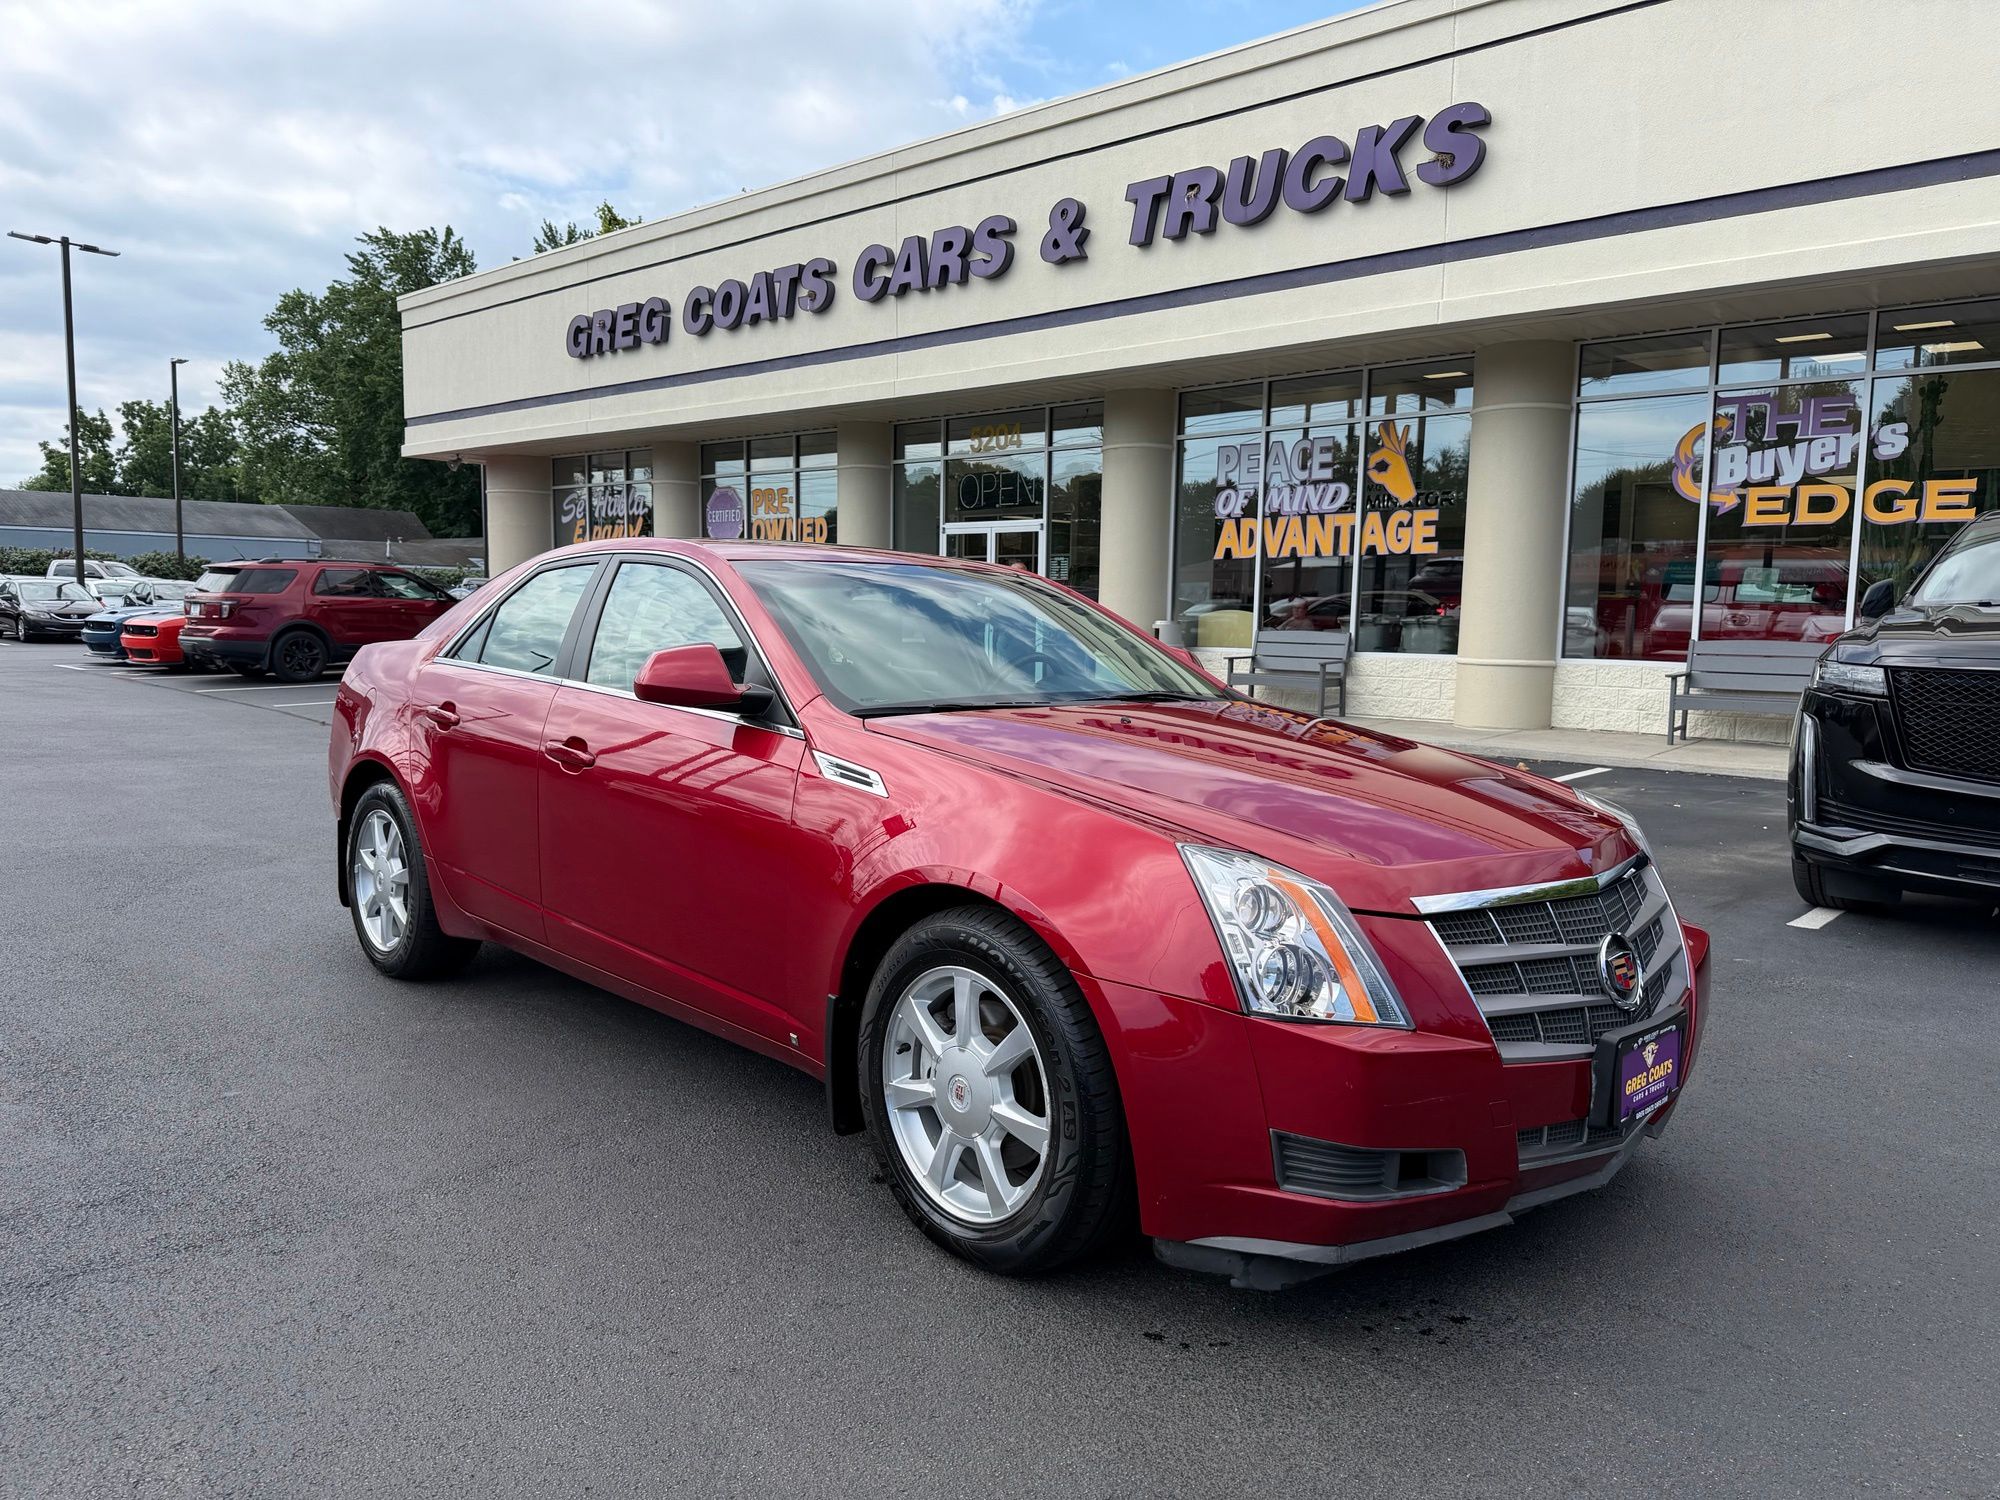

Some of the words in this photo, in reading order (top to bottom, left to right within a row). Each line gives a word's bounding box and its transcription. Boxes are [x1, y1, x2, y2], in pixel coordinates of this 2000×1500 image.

[566, 296, 671, 359] GREG
[683, 256, 837, 337] COATS
[852, 215, 1017, 302] CARS
[1040, 197, 1090, 265] &
[1125, 101, 1492, 247] TRUCKS
[1716, 392, 1857, 443] THE
[1216, 435, 1335, 487] PEACE
[561, 493, 587, 524] Se
[594, 486, 648, 518] Habla
[752, 487, 794, 515] PRE-
[959, 470, 1036, 509] OPEN
[1214, 487, 1255, 518] OF
[1264, 481, 1350, 516] MIND
[1741, 477, 1978, 527] EDGE
[707, 509, 741, 523] CERTIFIED
[1213, 509, 1440, 560] ADVANTAGE
[1625, 1071, 1648, 1096] GREG
[1648, 1058, 1673, 1083] COATS
